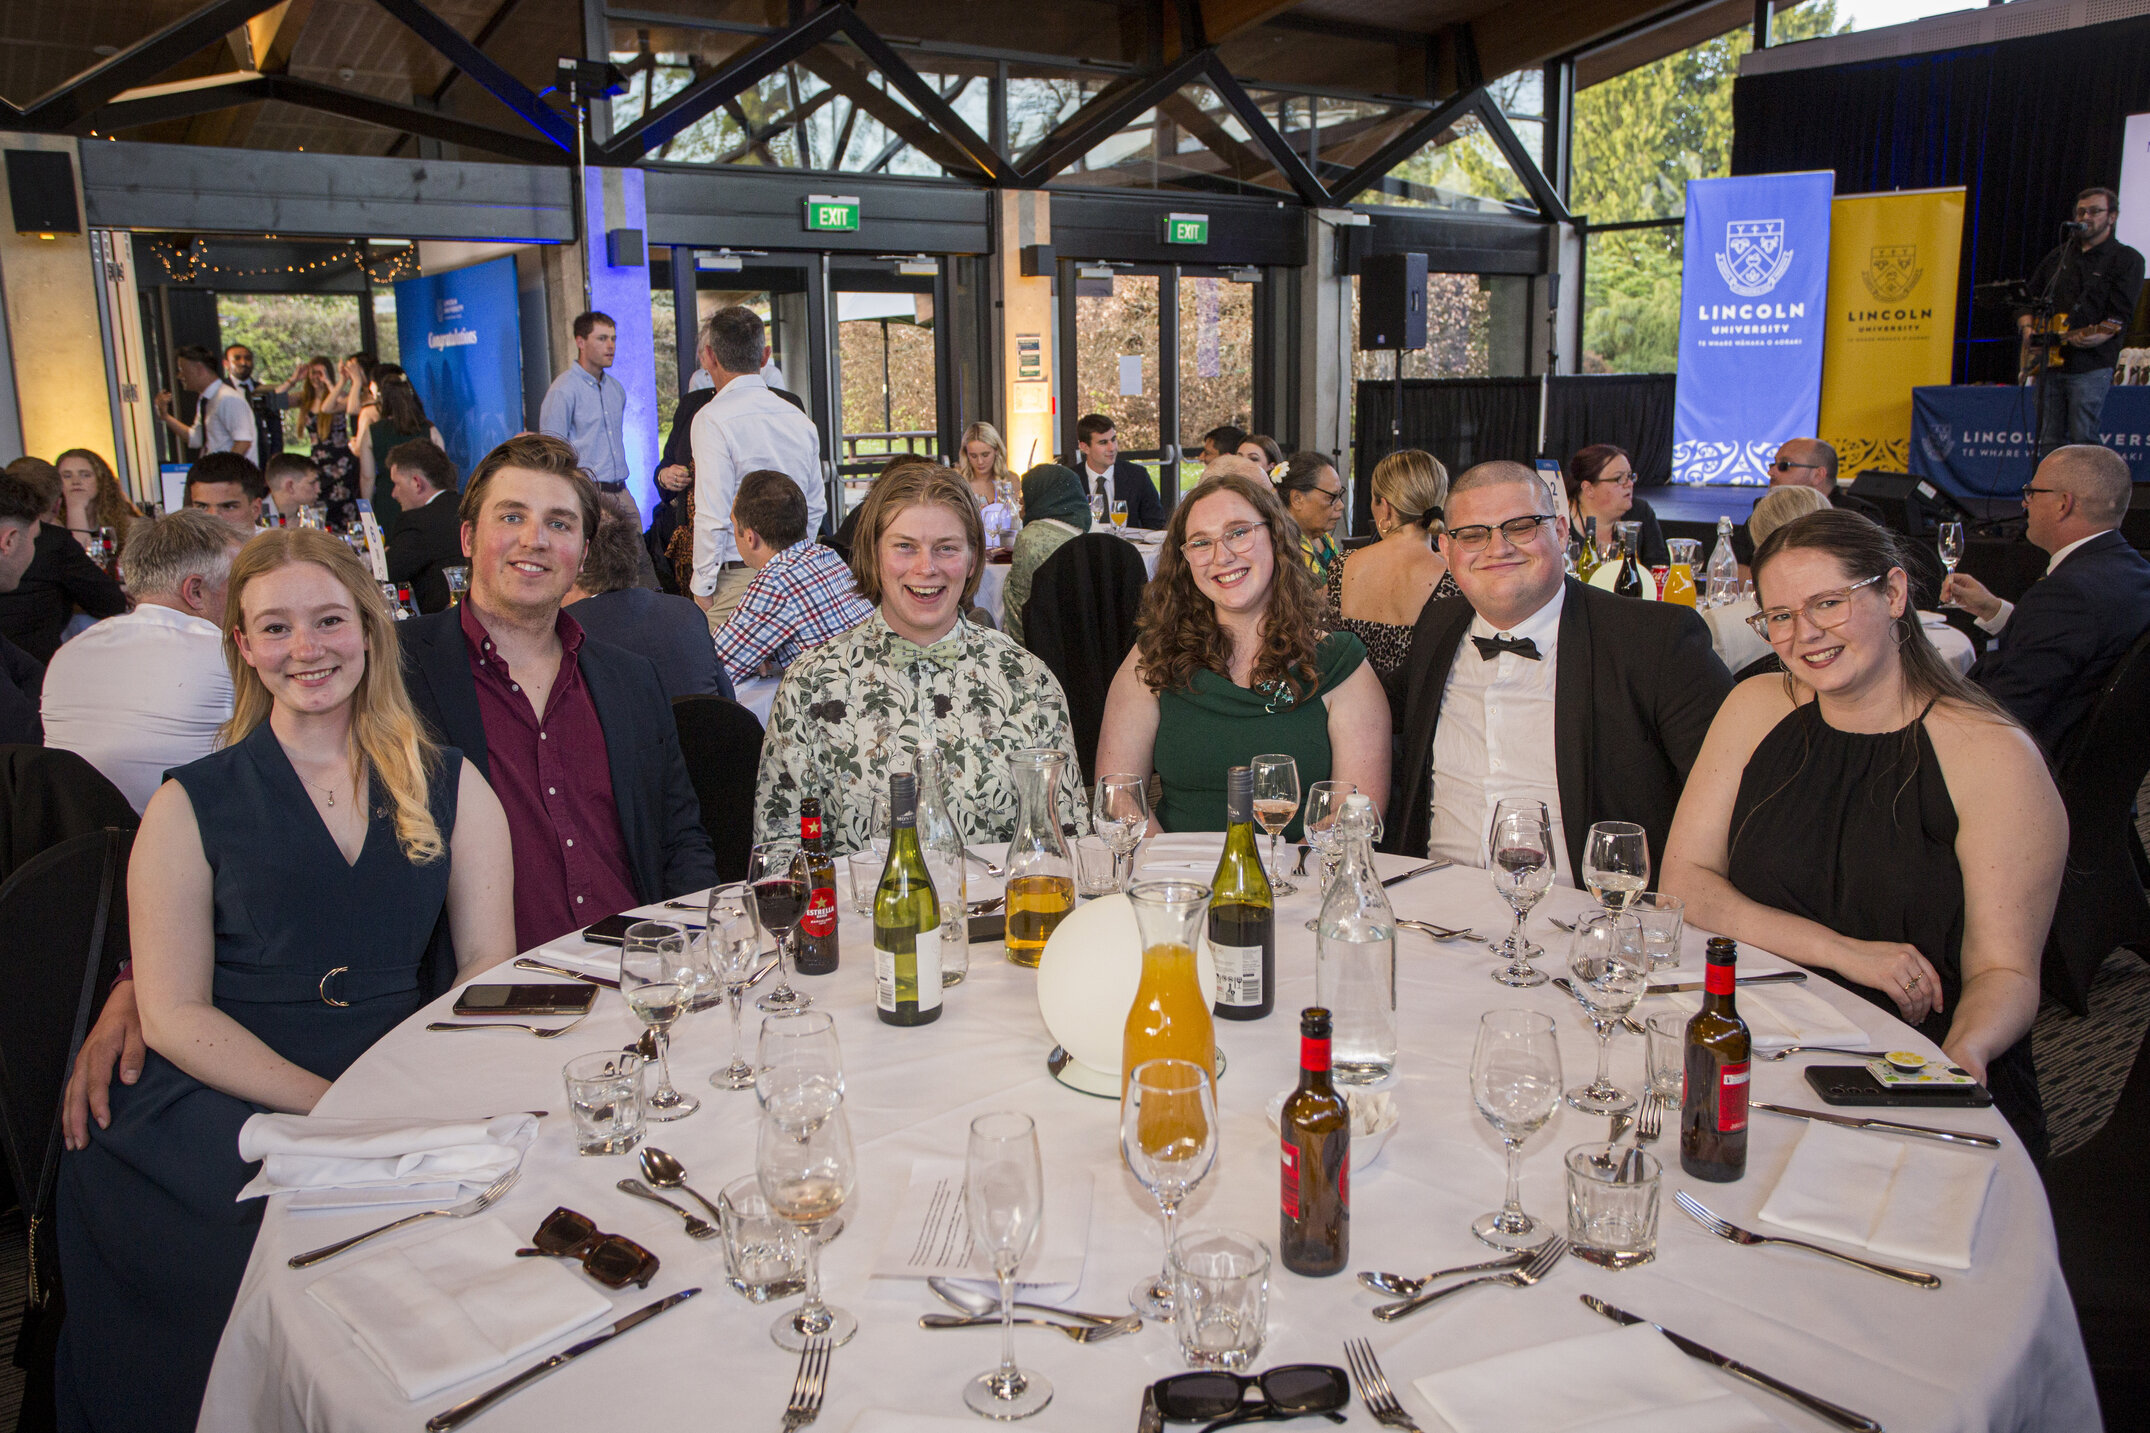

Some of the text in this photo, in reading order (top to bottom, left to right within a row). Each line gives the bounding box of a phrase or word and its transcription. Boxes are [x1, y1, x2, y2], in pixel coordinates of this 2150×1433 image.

[819, 207, 849, 226] EXIT
[1177, 223, 1200, 240] EXIT
[1698, 302, 1805, 321] LINCOLN
[1848, 308, 1932, 322] LINCOLN
[1711, 324, 1790, 335] UNIVERSITY
[1858, 324, 1920, 333] UNIVERSITY
[1963, 431, 2042, 444] LINCOL
[1962, 448, 1974, 457] TE
[806, 905, 834, 916] ESTRELLA
